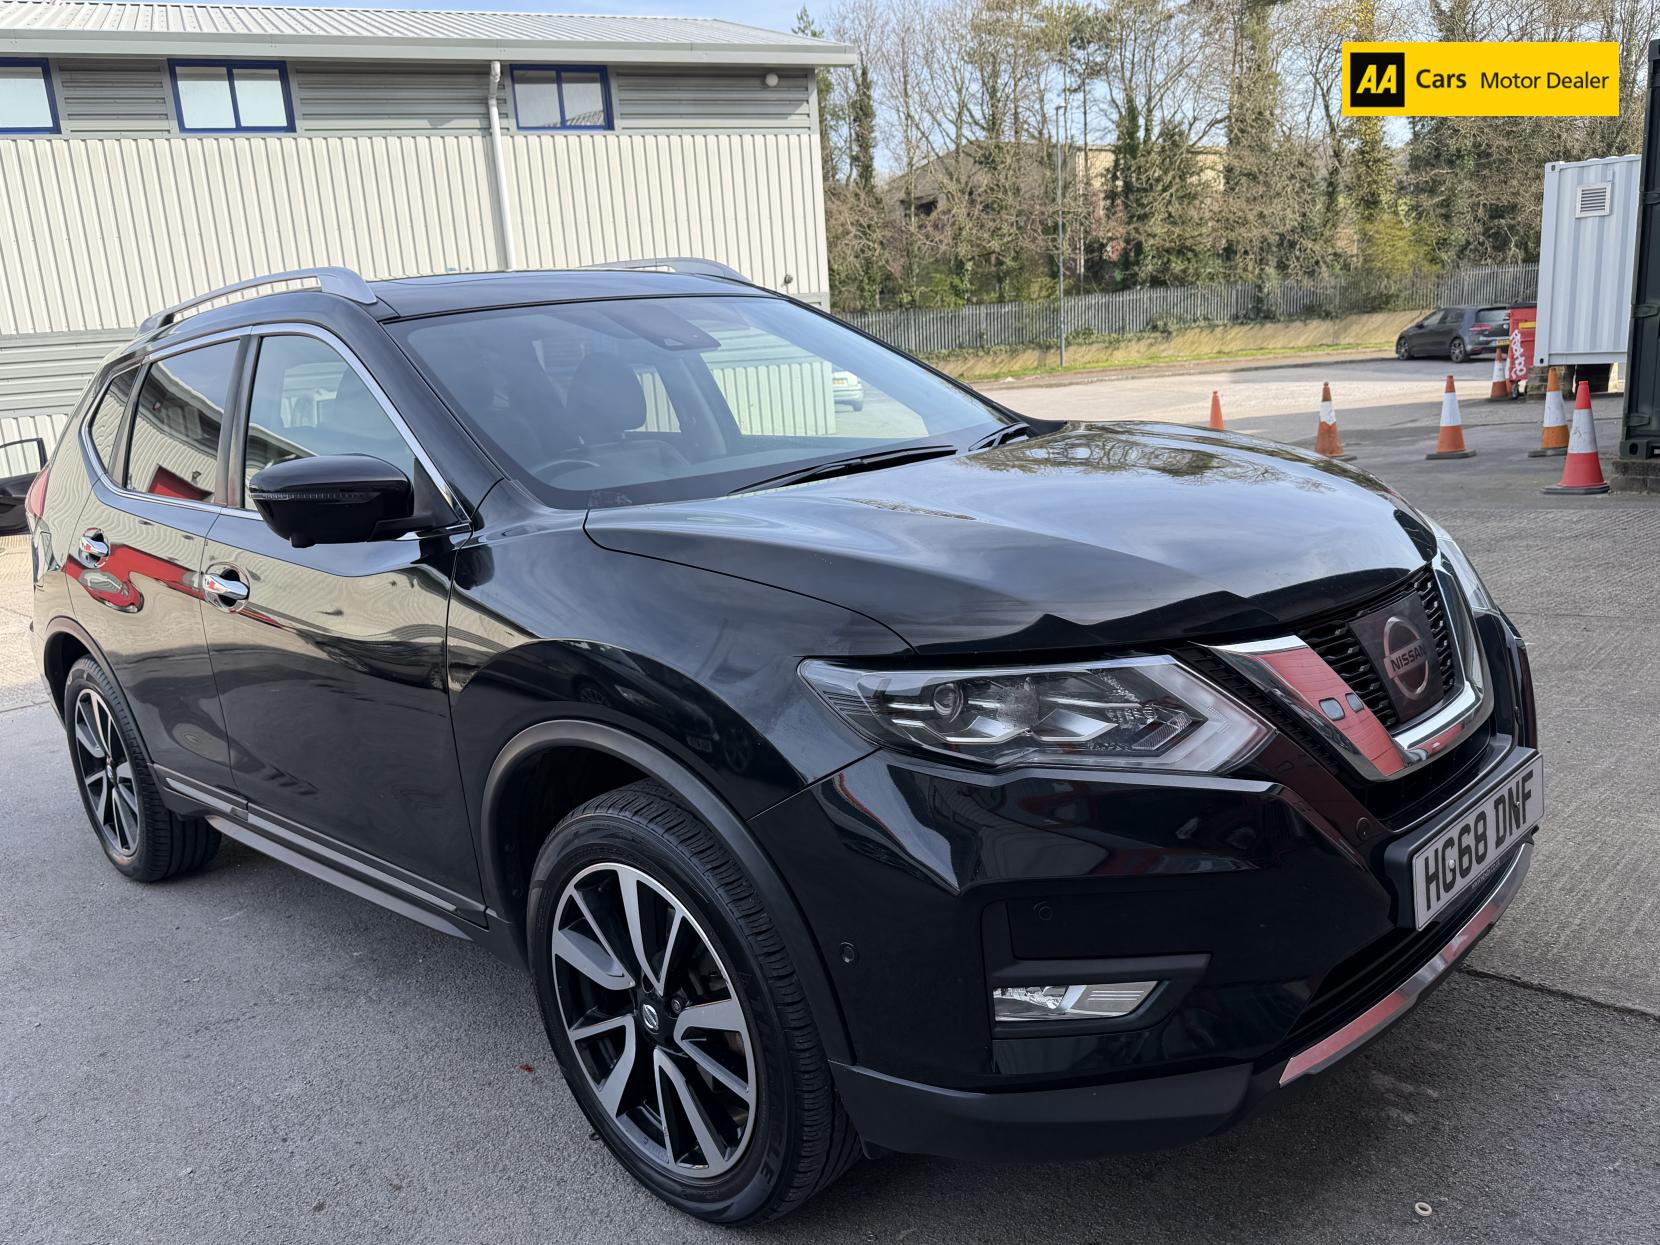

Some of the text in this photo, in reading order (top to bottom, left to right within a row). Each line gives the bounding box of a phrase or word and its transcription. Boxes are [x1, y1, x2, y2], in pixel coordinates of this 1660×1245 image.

[1390, 643, 1427, 672] NISSAN
[1424, 769, 1534, 912] HG68 DNF
